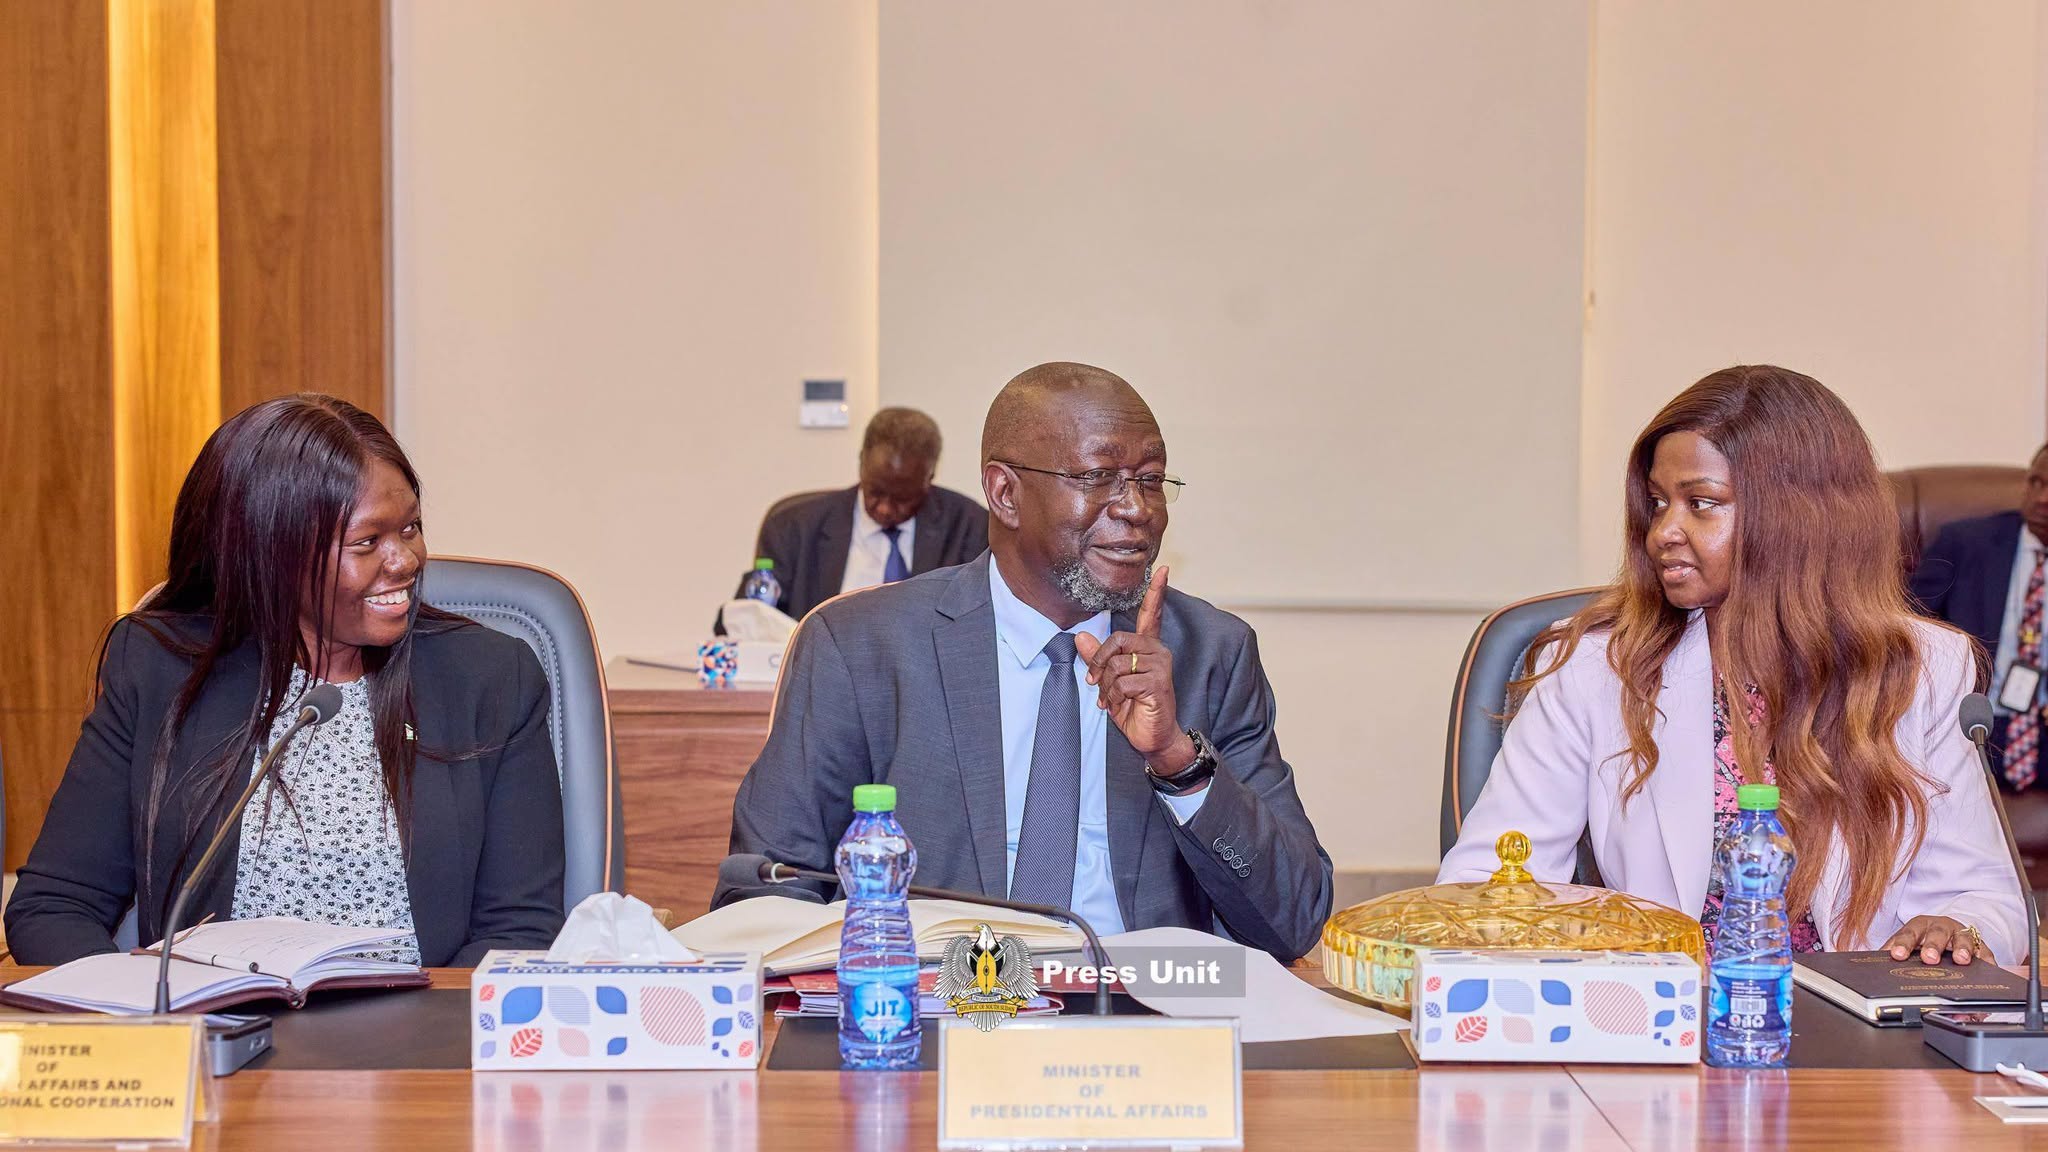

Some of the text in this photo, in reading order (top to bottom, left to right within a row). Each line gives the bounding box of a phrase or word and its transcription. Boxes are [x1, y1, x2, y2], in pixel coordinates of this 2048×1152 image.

[865, 1000, 899, 1017] JIT
[22, 1045, 92, 1057] INISTER
[36, 1062, 58, 1073] OF
[1042, 1065, 1142, 1078] MINISTER
[28, 1079, 100, 1091] AFFAIRS
[106, 1079, 142, 1091] AND
[1079, 1084, 1105, 1099] OF
[50, 1096, 175, 1108] COOPERATION
[970, 1104, 1209, 1119] PRESIDENTIAL AFFAIRS
